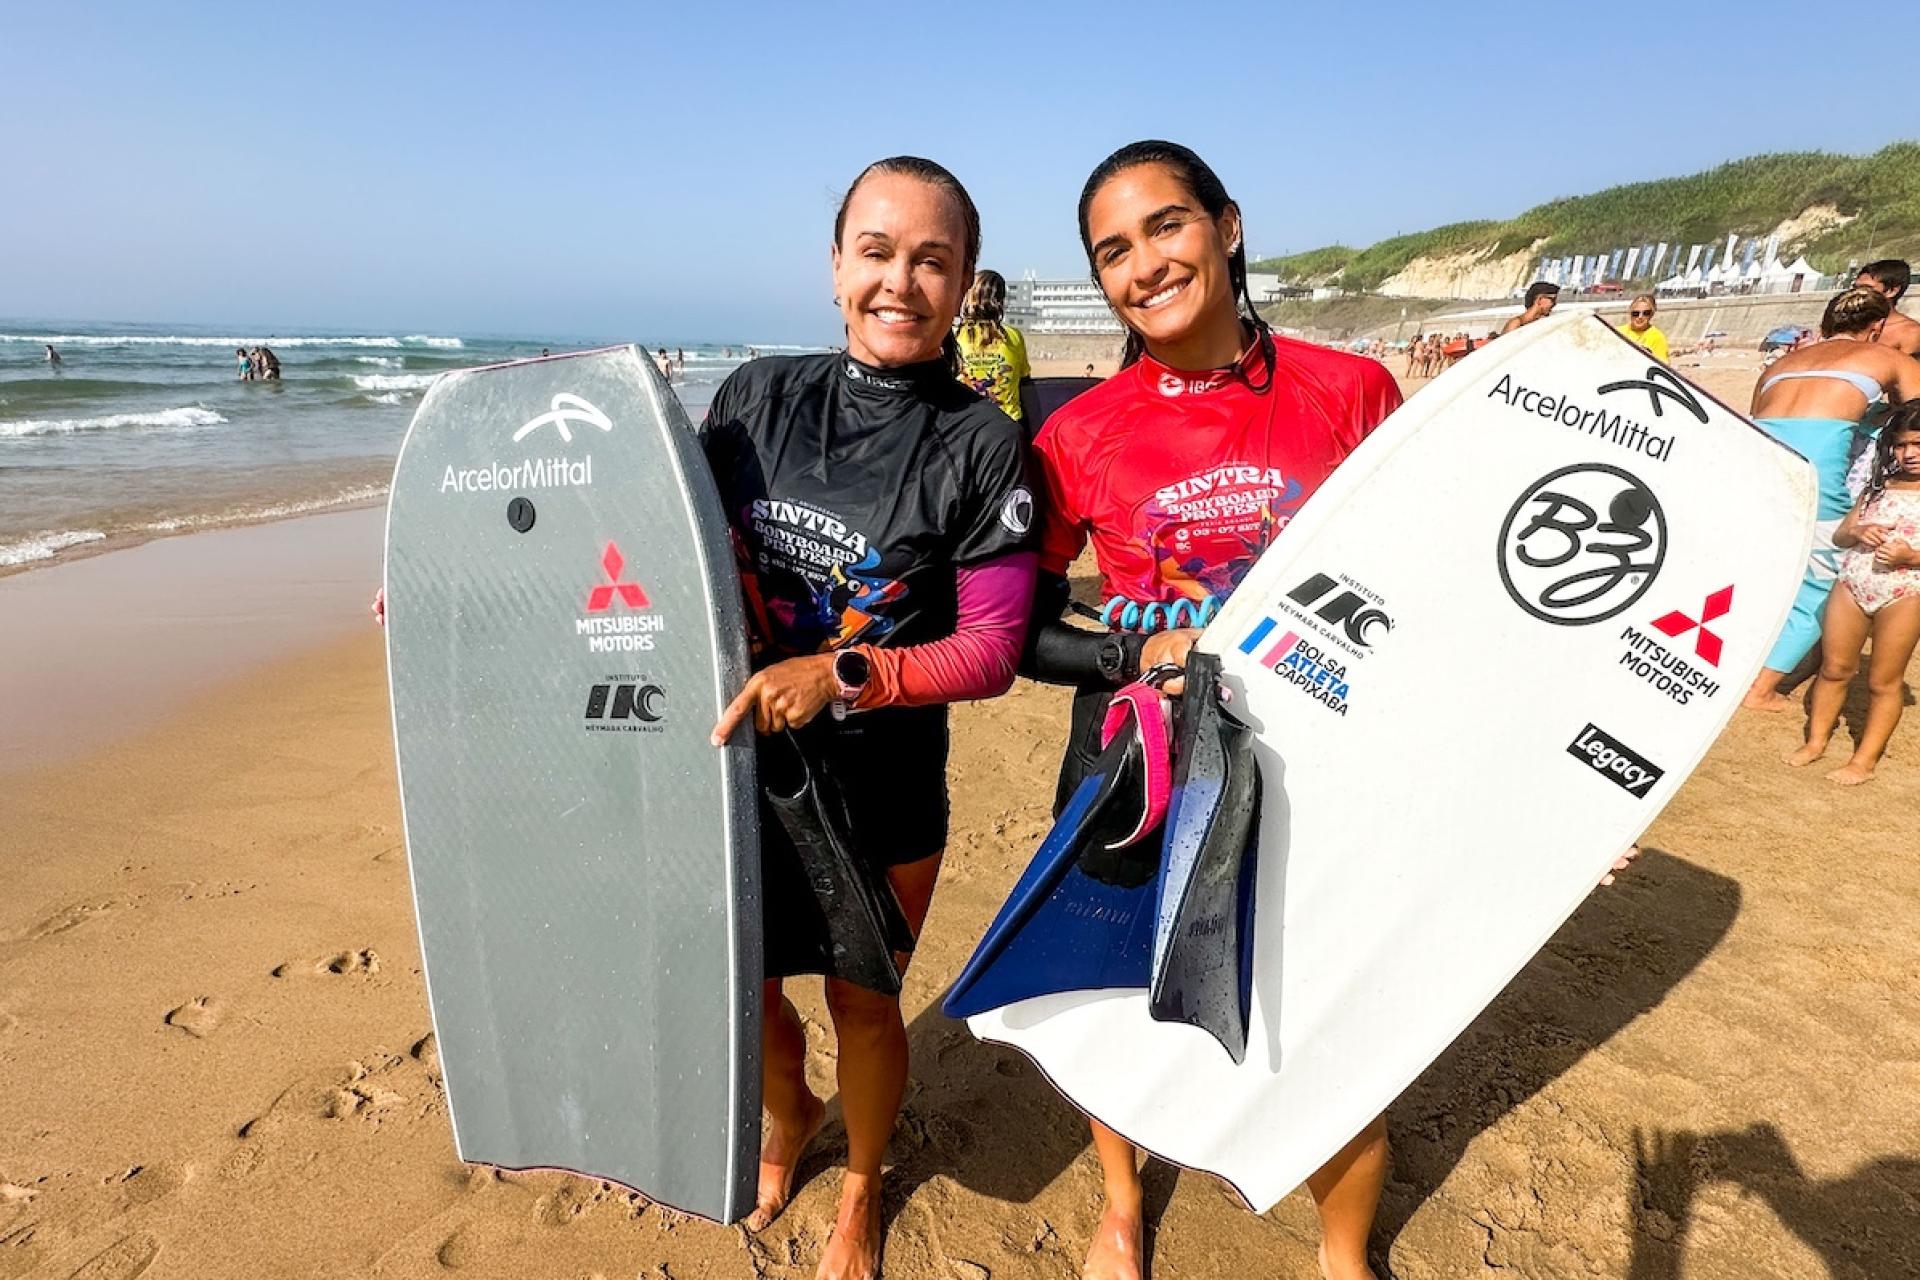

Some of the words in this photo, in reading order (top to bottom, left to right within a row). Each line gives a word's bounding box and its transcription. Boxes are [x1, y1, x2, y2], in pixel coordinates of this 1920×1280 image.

[1487, 373, 1675, 463] ArcelorMittal
[441, 454, 592, 493] ArcelorMittal
[1155, 466, 1285, 507] SINTRA
[1167, 488, 1279, 515] BODYBOARD
[1181, 509, 1219, 523] PRO
[751, 499, 867, 556] SINTRA
[755, 520, 858, 564] BODYBOARD
[763, 534, 796, 556] PRO
[1339, 573, 1385, 606] INSTITUTO
[576, 615, 664, 634] MITSUBISHI
[590, 634, 654, 652] MOTORS
[1278, 601, 1319, 631] NEYMARA
[1319, 627, 1364, 660] CARVALHO
[1284, 652, 1350, 700] ATLETA
[1295, 639, 1347, 679] BOLSA
[1619, 651, 1695, 705] MOTORS
[1620, 625, 1720, 698] MITSUBISHI
[1274, 662, 1349, 717] CAPIXABA
[1573, 727, 1658, 790] Legacy
